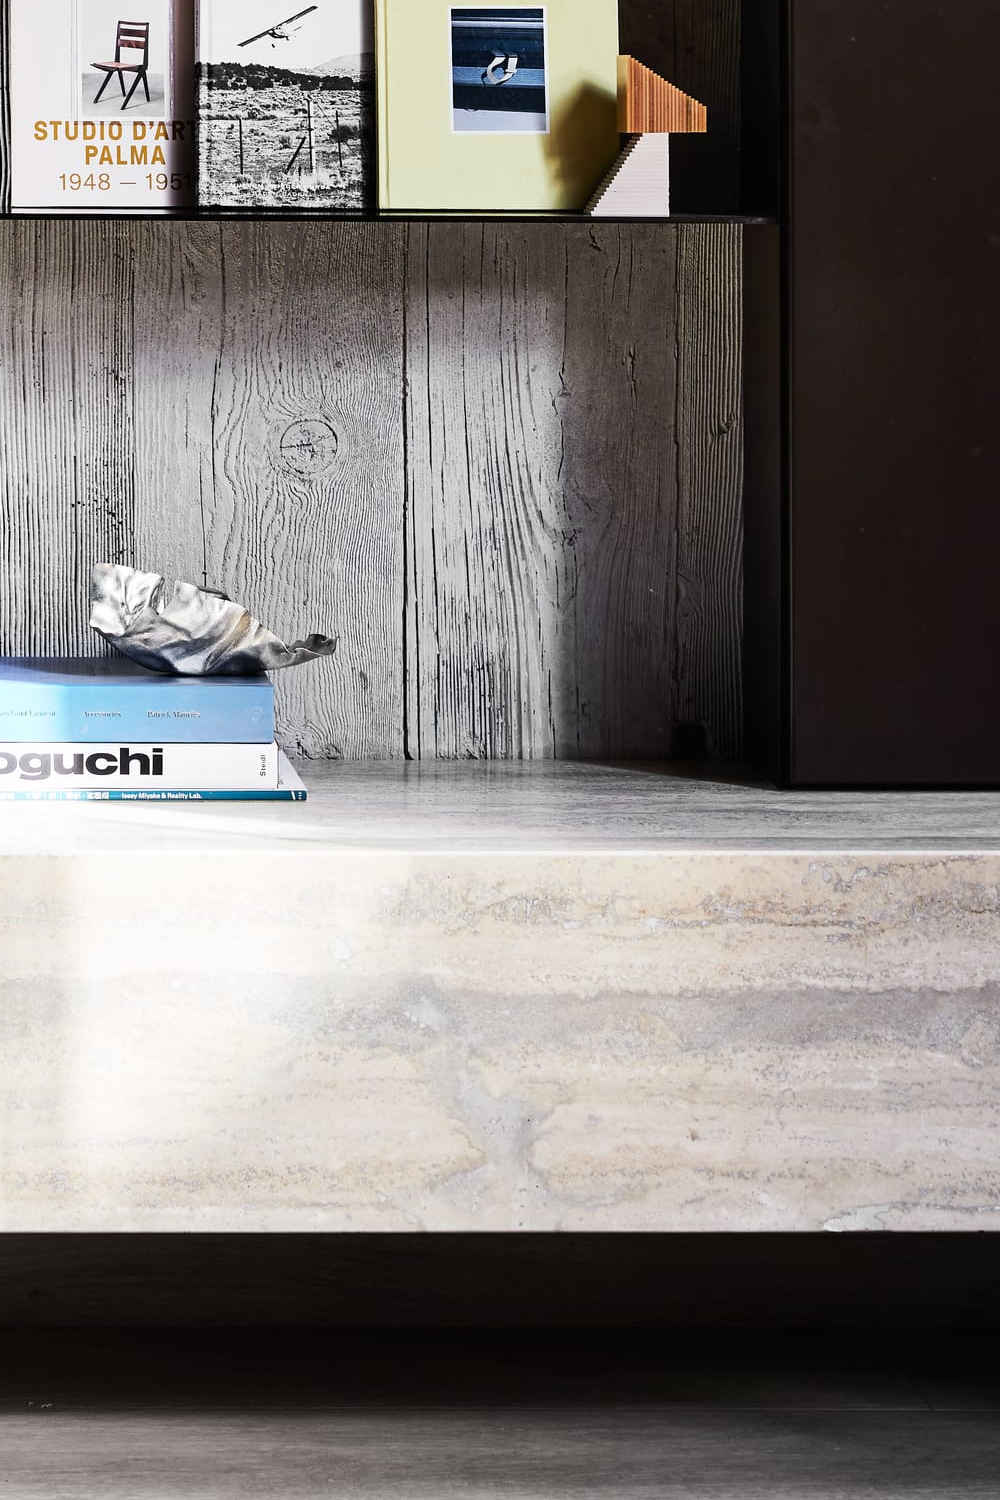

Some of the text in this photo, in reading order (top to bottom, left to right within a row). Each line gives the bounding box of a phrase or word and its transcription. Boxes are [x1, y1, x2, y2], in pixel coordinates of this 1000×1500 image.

[33, 120, 123, 141] STUDIO
[85, 145, 166, 165] PALMA
[59, 173, 111, 191] 1948
[146, 173, 191, 191] 1951
[147, 709, 171, 718] Patrick
[259, 754, 267, 777] Steidl
